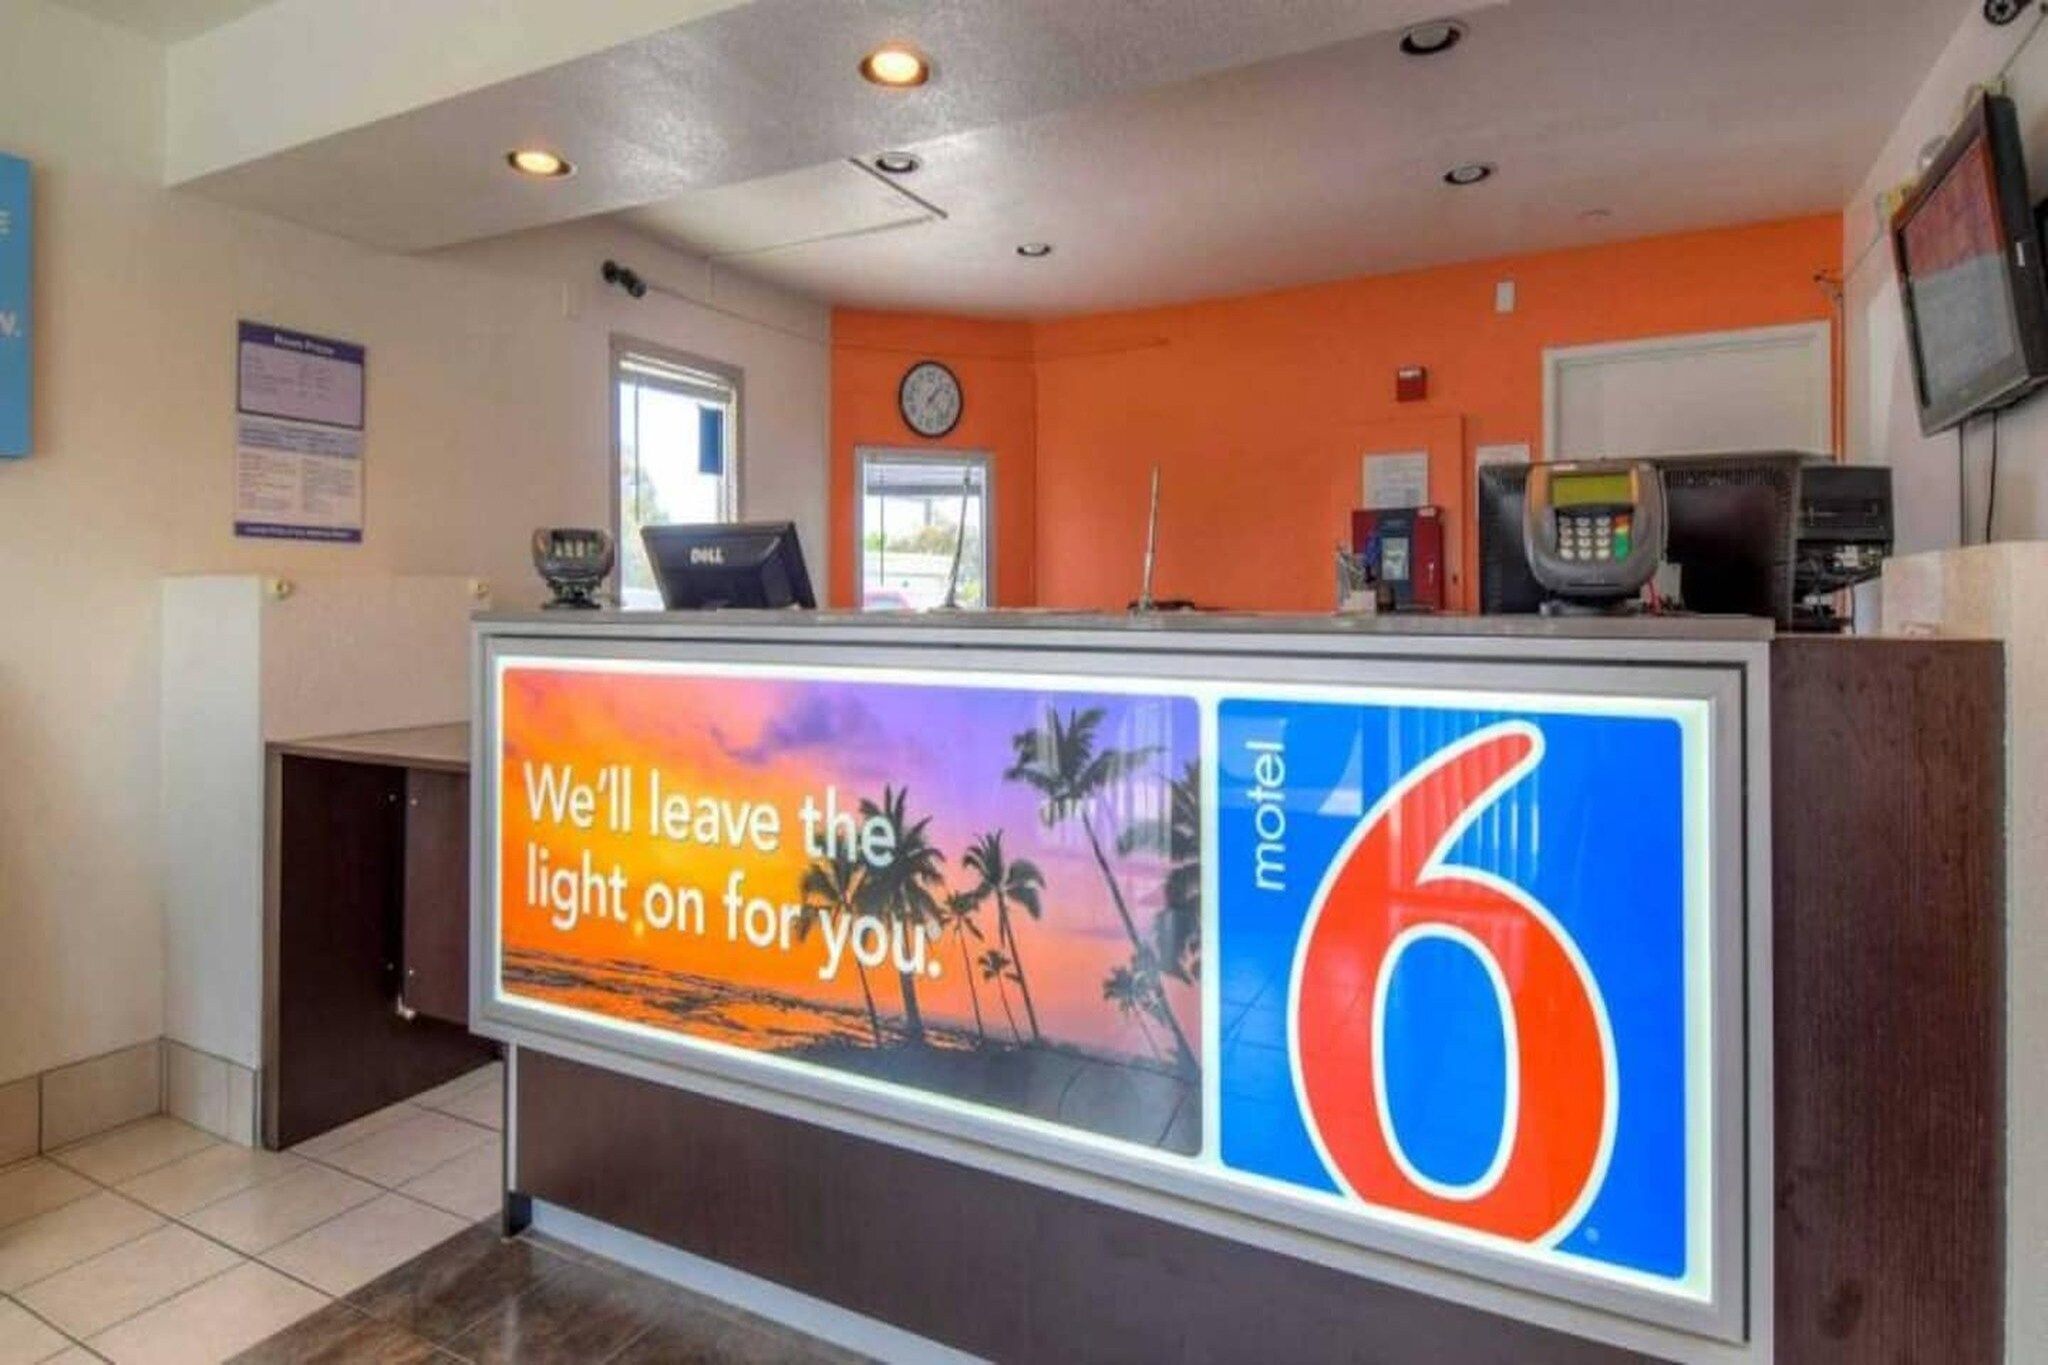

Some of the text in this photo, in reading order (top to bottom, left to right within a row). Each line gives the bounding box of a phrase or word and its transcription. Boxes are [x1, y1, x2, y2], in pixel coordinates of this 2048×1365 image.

[690, 547, 724, 565] DELL
[524, 761, 897, 867] We'll leave the
[1245, 740, 1286, 890] motel
[526, 842, 942, 980] light on for you.
[1286, 719, 1619, 1252] 6
